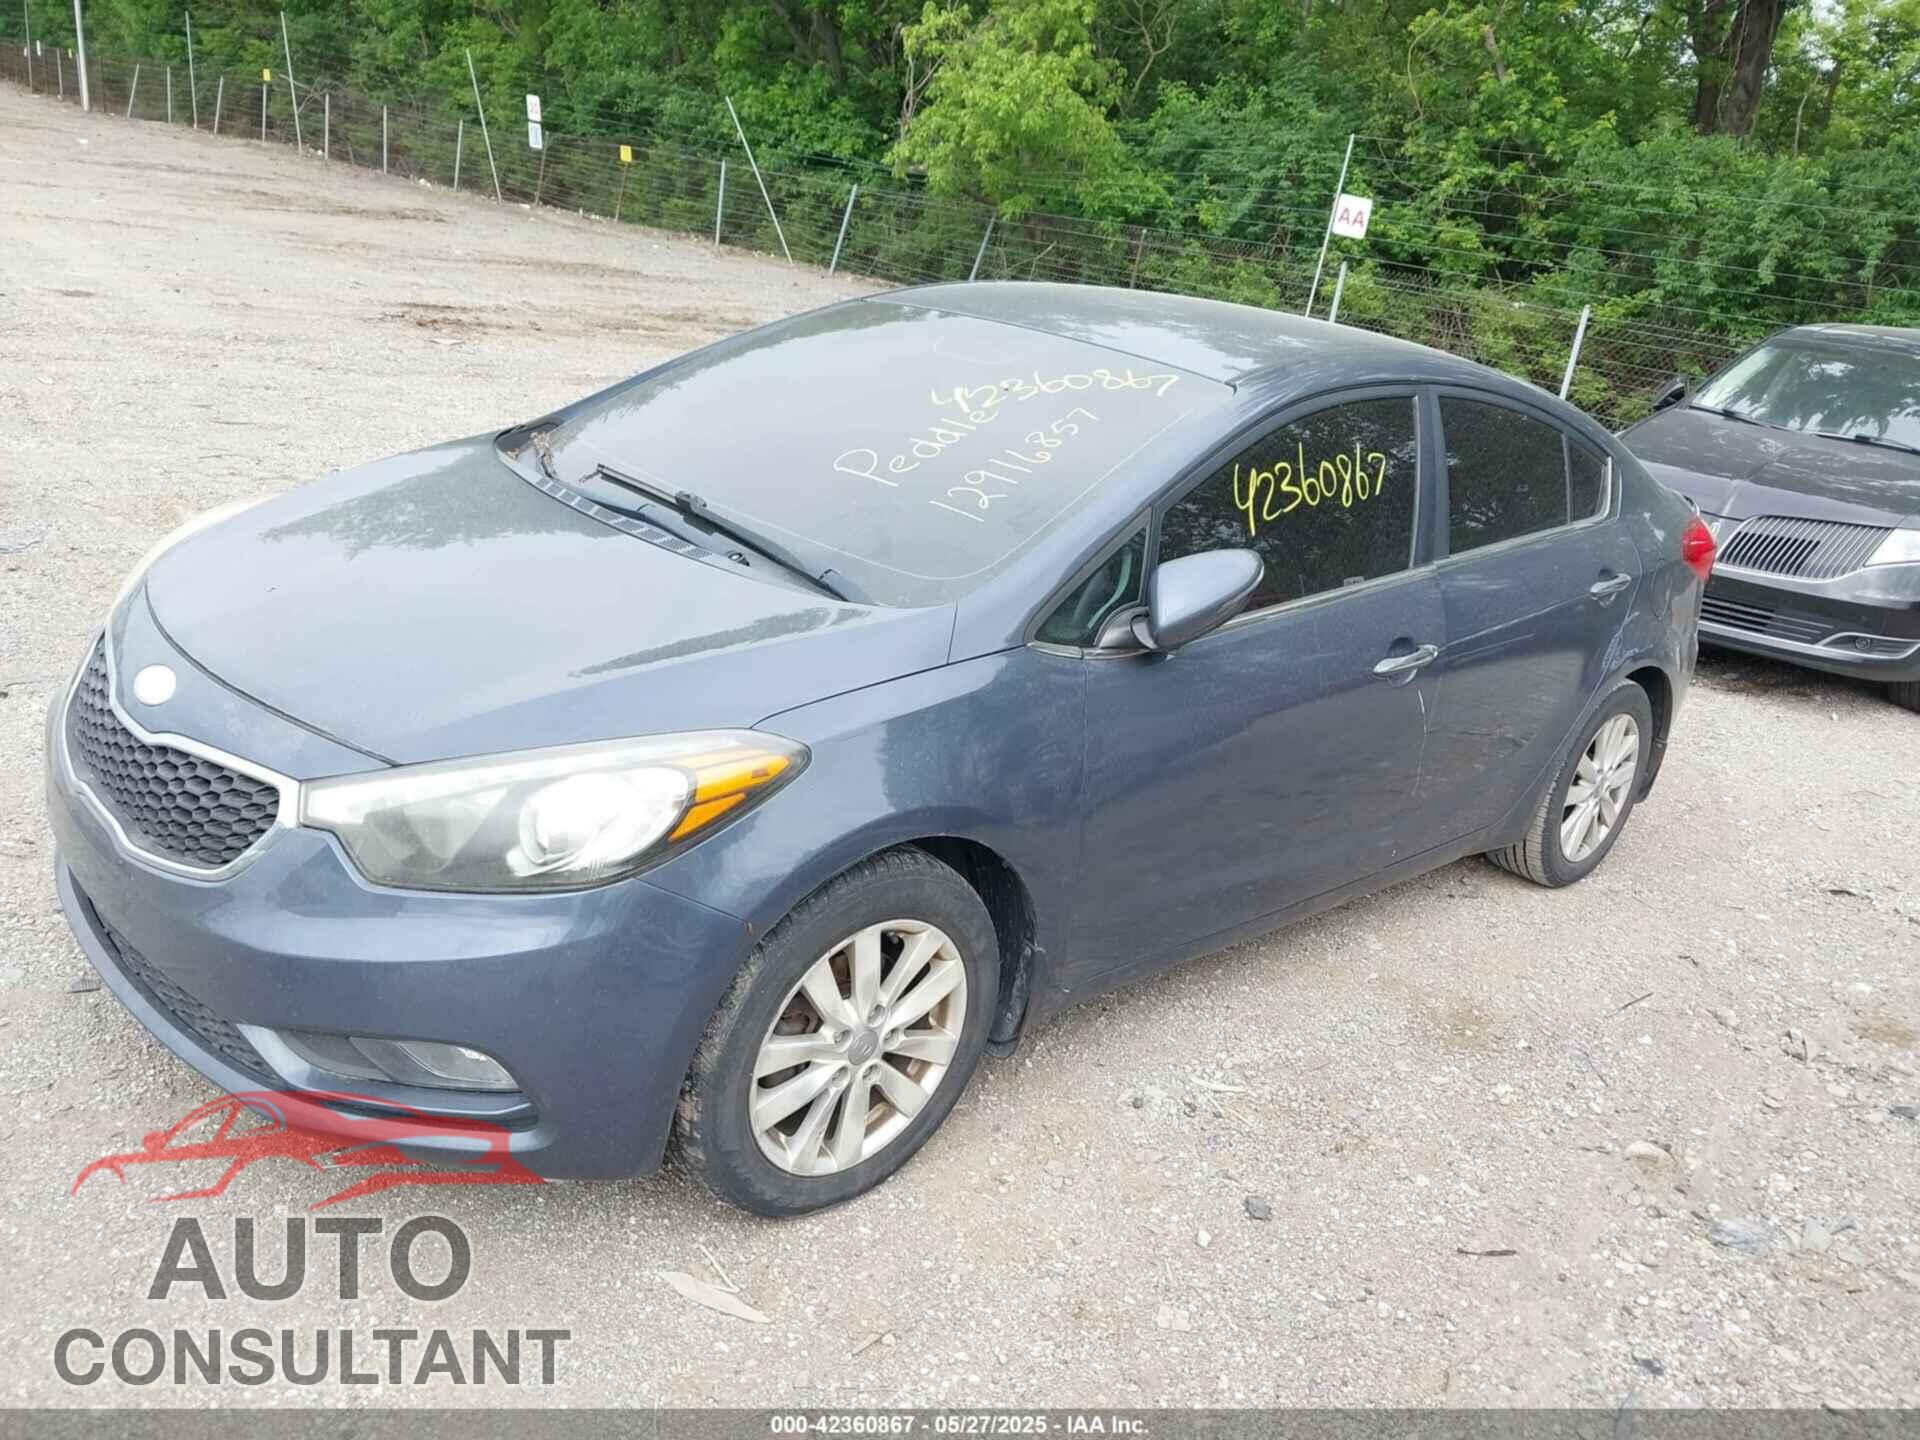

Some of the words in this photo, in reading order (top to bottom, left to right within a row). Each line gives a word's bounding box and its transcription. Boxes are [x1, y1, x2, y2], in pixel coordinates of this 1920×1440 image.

[1338, 207, 1365, 227] AA
[931, 369, 1181, 413] 42360867
[833, 409, 999, 487] Peddle
[929, 407, 1101, 522] 12916857
[1234, 441, 1386, 537] 42360867
